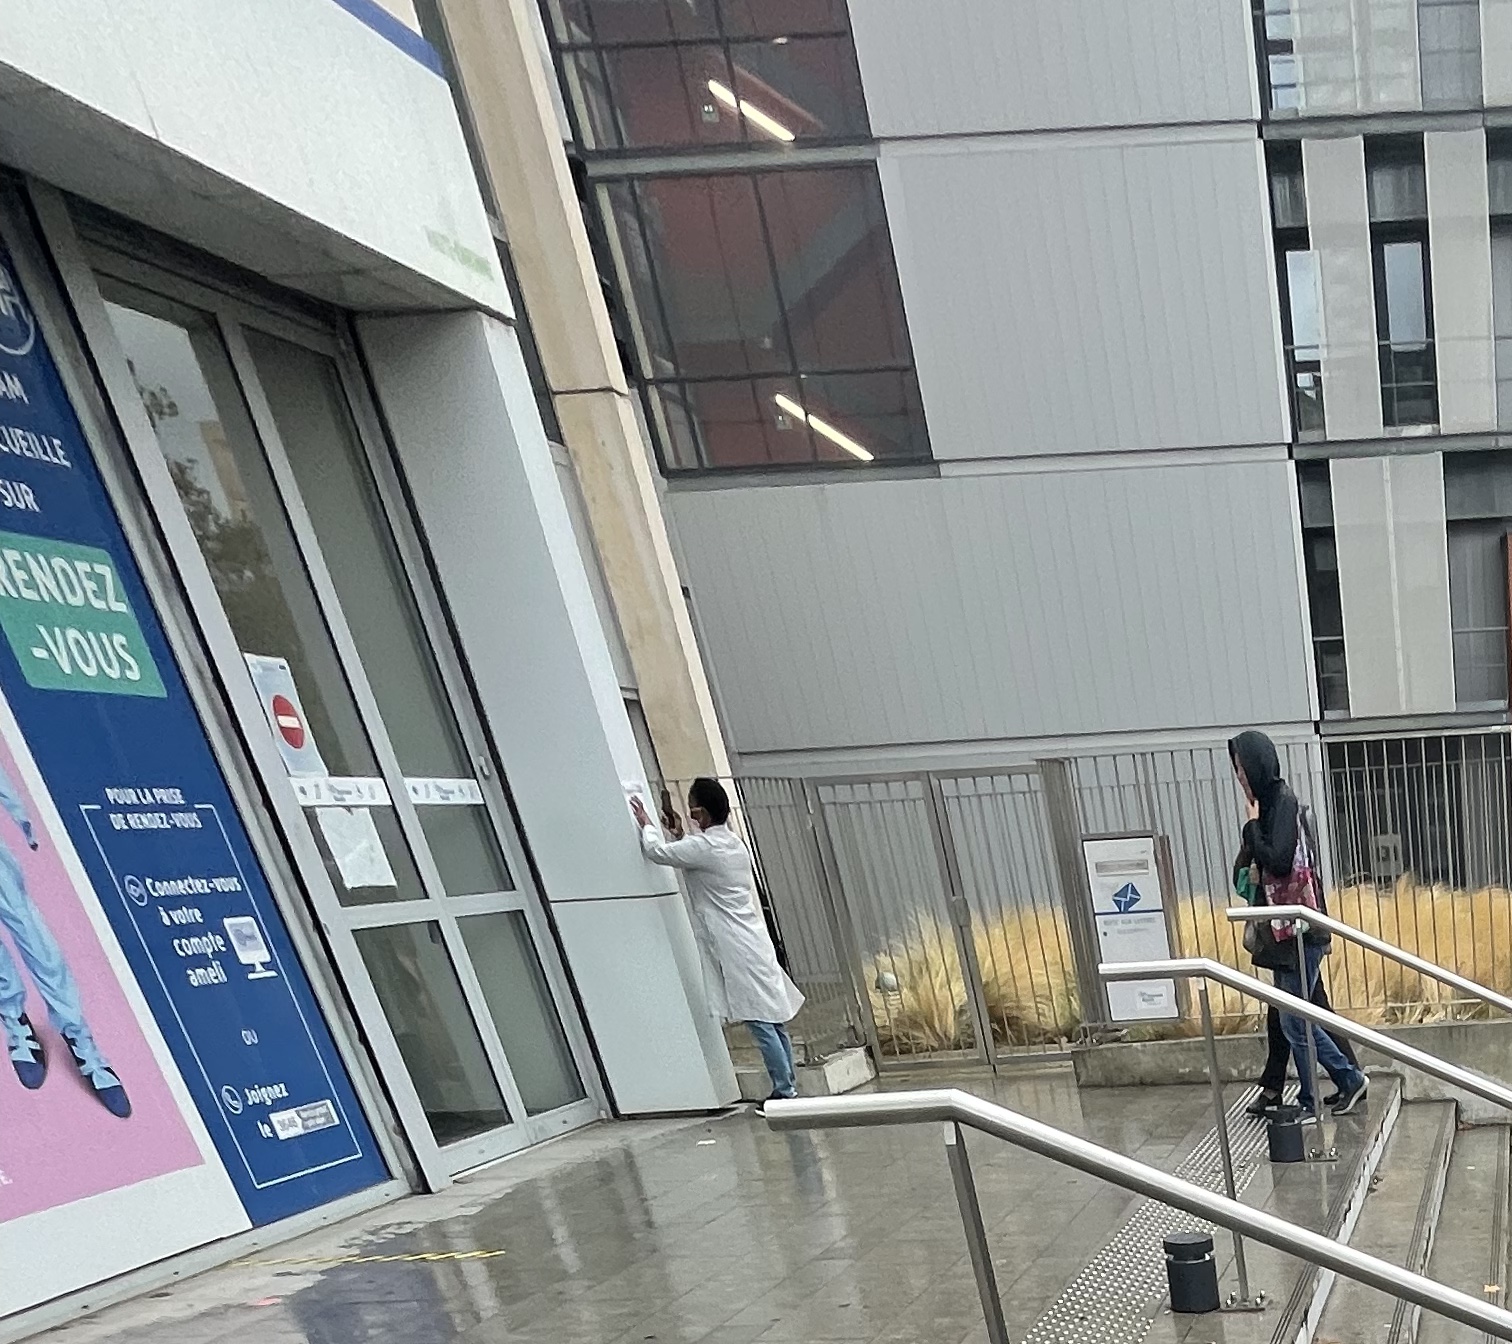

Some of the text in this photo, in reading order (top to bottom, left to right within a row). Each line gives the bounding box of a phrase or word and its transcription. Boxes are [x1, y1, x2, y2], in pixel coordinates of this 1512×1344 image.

[0, 479, 41, 512] SUR
[31, 624, 141, 681] -VOUS
[105, 787, 186, 805] POUR LA PRISE
[109, 812, 202, 830] DE RENDEZ-VOUS
[145, 875, 242, 897] Connectez-vous
[158, 905, 203, 926] à votre
[173, 931, 227, 959] compte
[186, 960, 228, 987] ameli
[244, 1082, 289, 1106] Joignez
[257, 1119, 274, 1138] le
